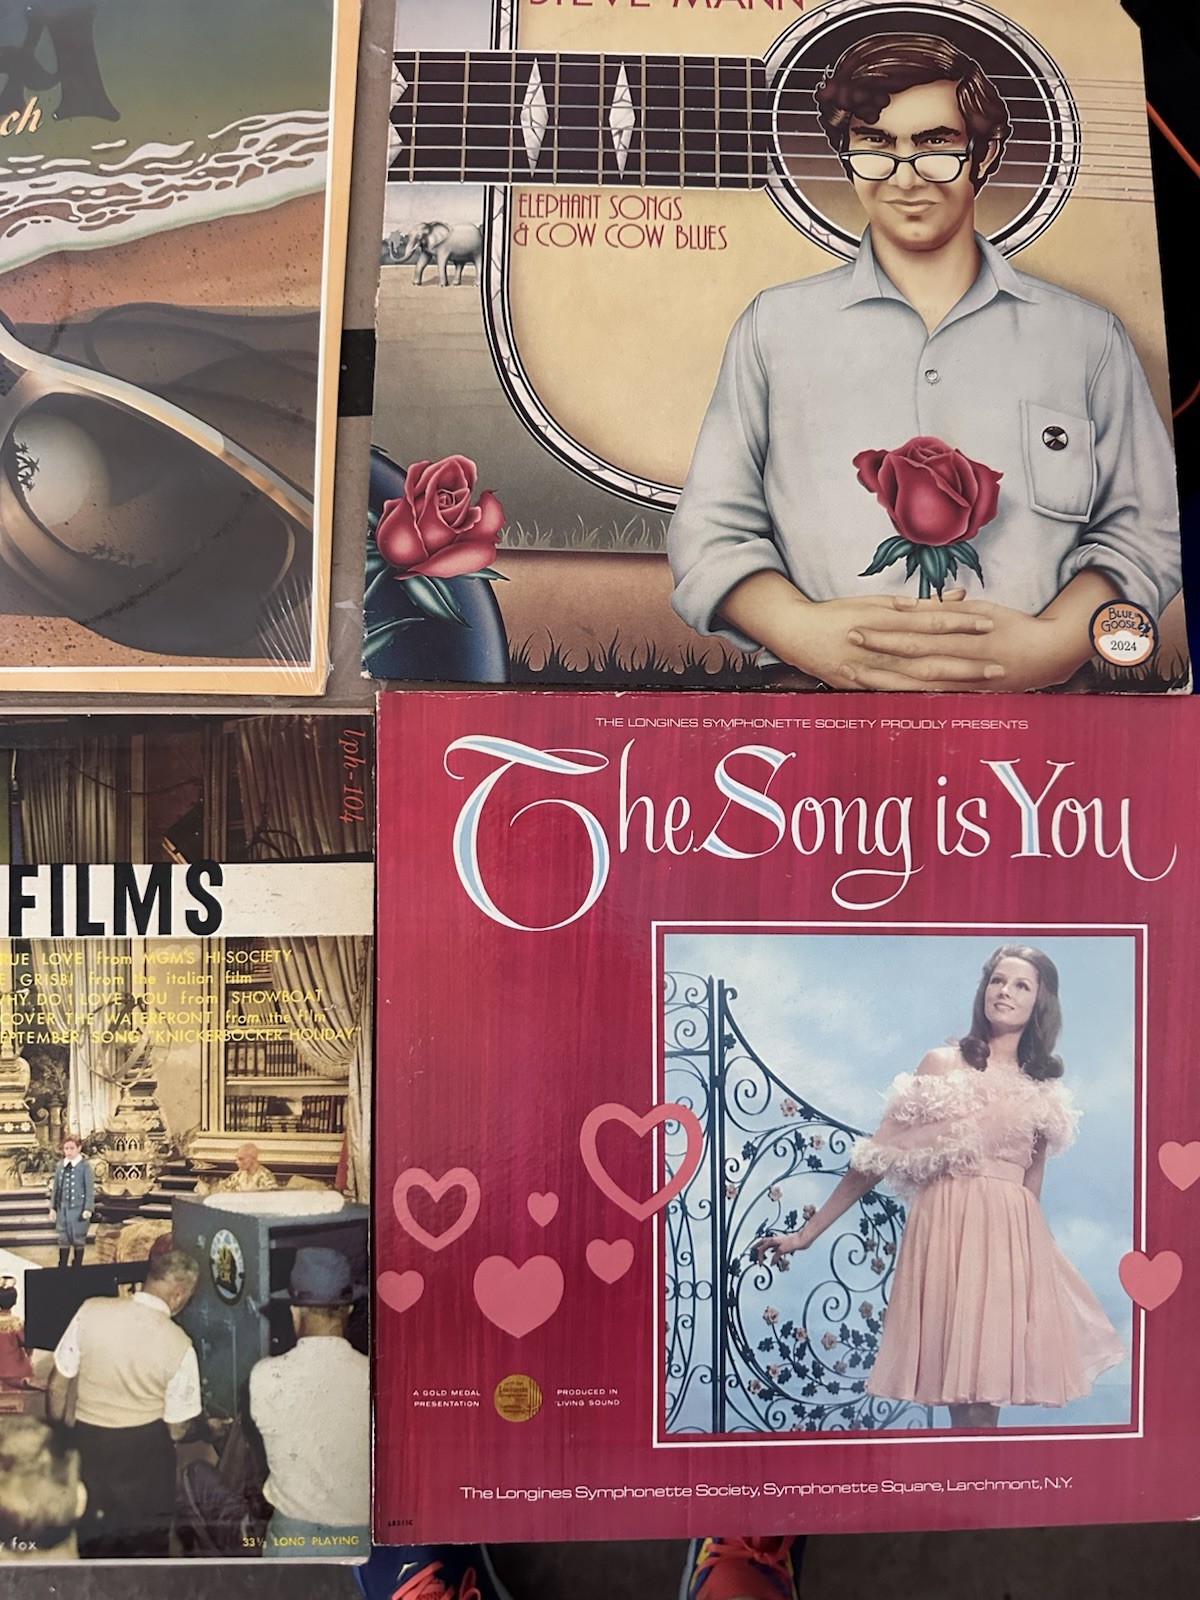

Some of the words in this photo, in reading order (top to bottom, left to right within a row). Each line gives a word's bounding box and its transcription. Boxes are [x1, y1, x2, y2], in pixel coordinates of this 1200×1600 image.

[518, 193, 601, 219] ELEPHANT
[609, 195, 682, 220] SONGS
[513, 222, 529, 247] &
[536, 222, 597, 248] COW
[604, 223, 667, 249] COW
[675, 225, 727, 250] BLUES
[1108, 607, 1135, 621] BLUE
[1101, 620, 1137, 632] GOOSE
[1110, 640, 1137, 651] 2024
[596, 717, 624, 727] THE
[628, 717, 699, 728] LONGINES
[702, 718, 811, 729] SYMPHONETTE
[815, 719, 877, 729] SOCIETY
[881, 720, 947, 730] PROUDLY
[951, 720, 1029, 730] PRESENTS
[444, 734, 695, 932] The
[692, 745, 925, 911] Song
[937, 775, 991, 857] is
[980, 758, 1177, 882] You
[8, 861, 224, 937] FILMS
[42, 952, 83, 966] LOVE
[97, 951, 132, 965] from
[144, 950, 195, 965] MGM'S
[206, 949, 293, 964] HI-SOCIETY
[20, 973, 74, 987] GRISBI
[89, 973, 125, 986] from
[135, 972, 156, 985] the
[166, 971, 214, 986] italian
[225, 970, 252, 984] film
[37, 993, 62, 1006] DO
[82, 992, 123, 1006] LOVE
[132, 992, 168, 1005] YOU
[181, 990, 219, 1005] from
[231, 989, 324, 1004] SHOWBOAT
[0, 1013, 56, 1026] COVER
[65, 1012, 95, 1026] THE
[105, 1011, 213, 1026] WATERFRONT
[225, 1010, 259, 1025] from
[269, 1010, 291, 1024] the
[300, 1008, 326, 1023] film
[0, 1031, 79, 1045] EPTEMBER
[91, 1030, 141, 1044] SONG
[460, 1486, 493, 1499] The
[497, 1487, 572, 1501] Longines
[575, 1485, 692, 1500] Symphonette
[696, 1484, 761, 1498] Society,
[763, 1482, 878, 1497] Symphonette
[881, 1480, 944, 1494] Square,
[947, 1478, 1042, 1491] Larchmont,
[1044, 1477, 1073, 1489] N.Y.
[12, 1536, 37, 1550] fox
[273, 1537, 305, 1546] LONG
[312, 1535, 359, 1546] PLAYING
